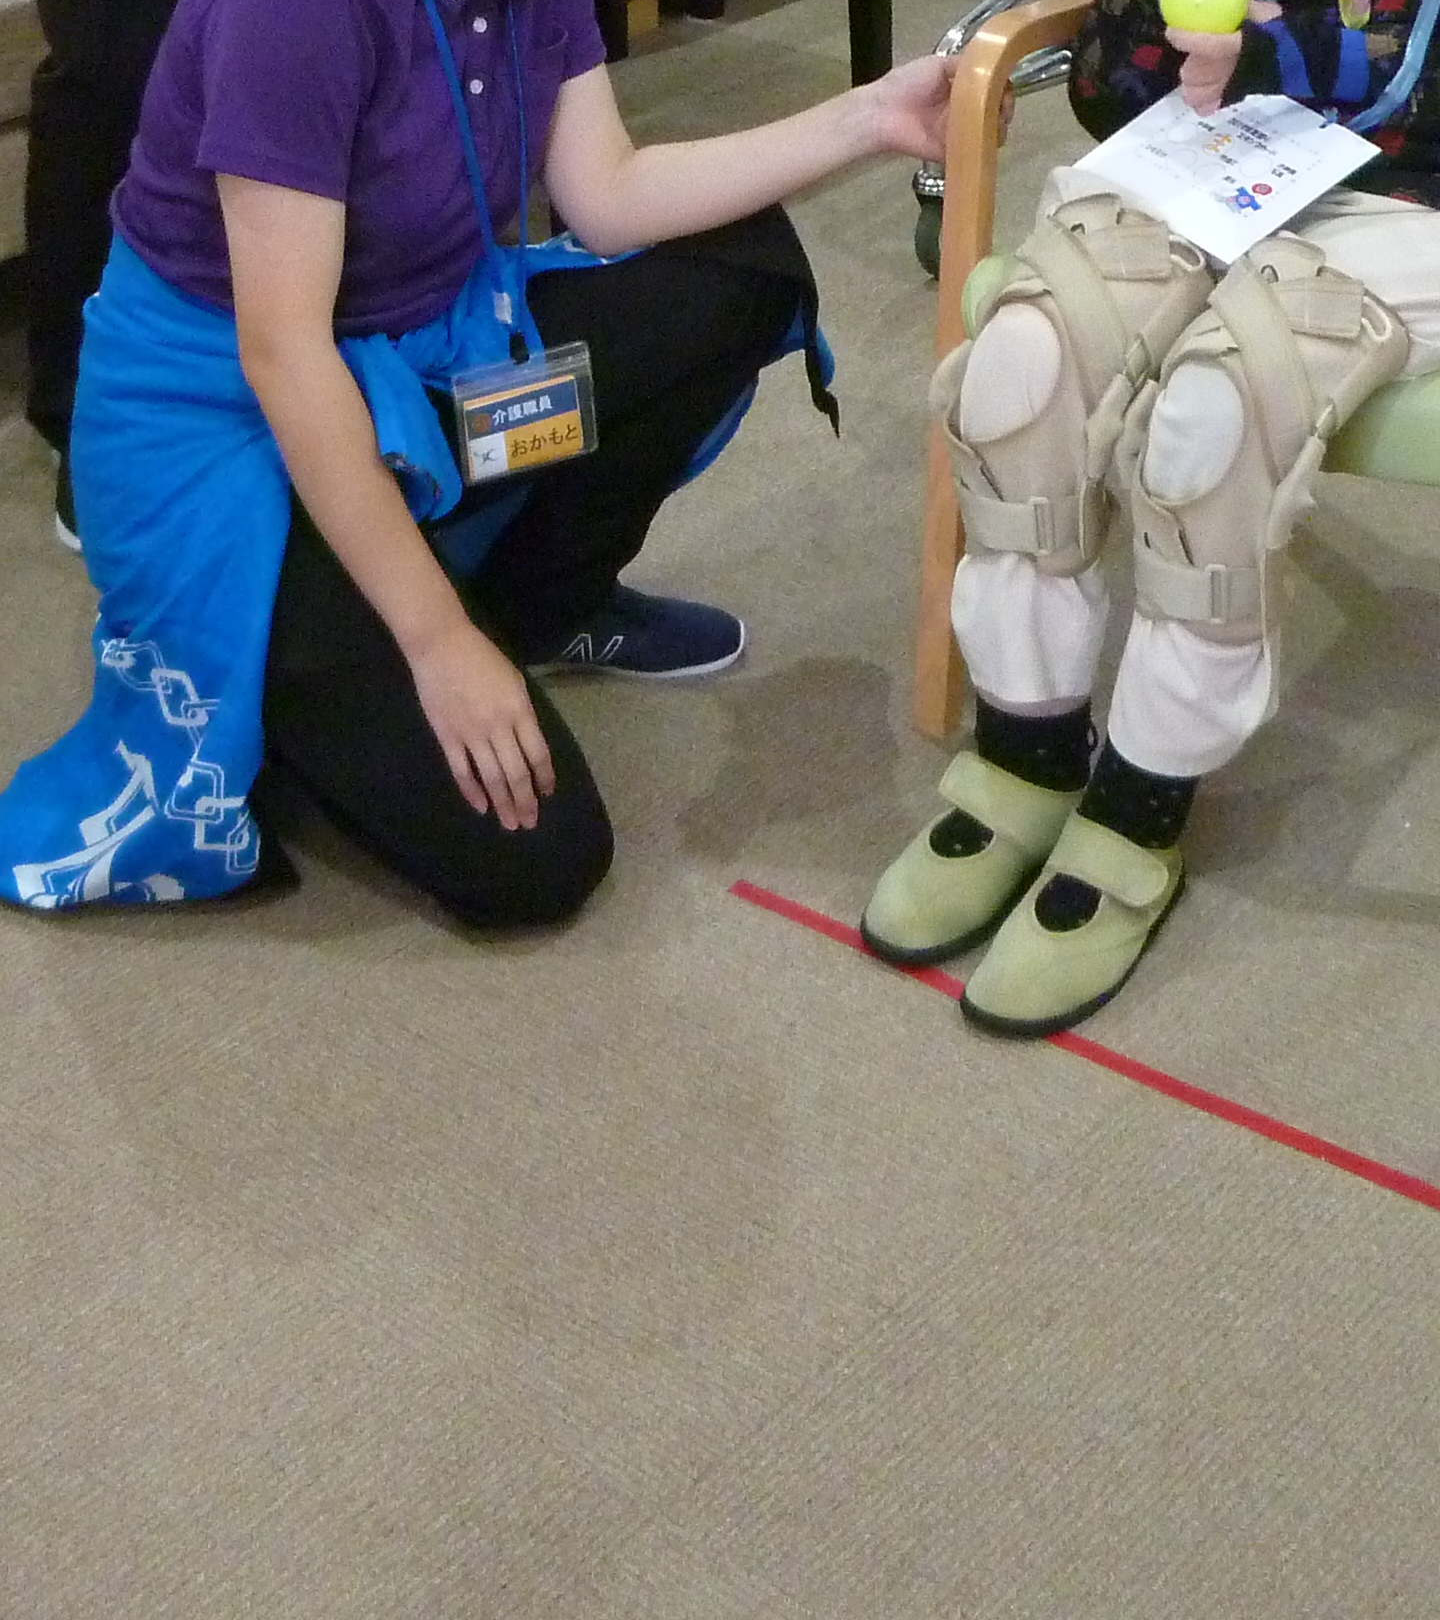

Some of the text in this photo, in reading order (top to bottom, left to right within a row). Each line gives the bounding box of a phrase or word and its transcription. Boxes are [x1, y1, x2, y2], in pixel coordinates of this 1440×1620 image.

[492, 394, 554, 427] 介護職員
[510, 423, 580, 459] おかもと
